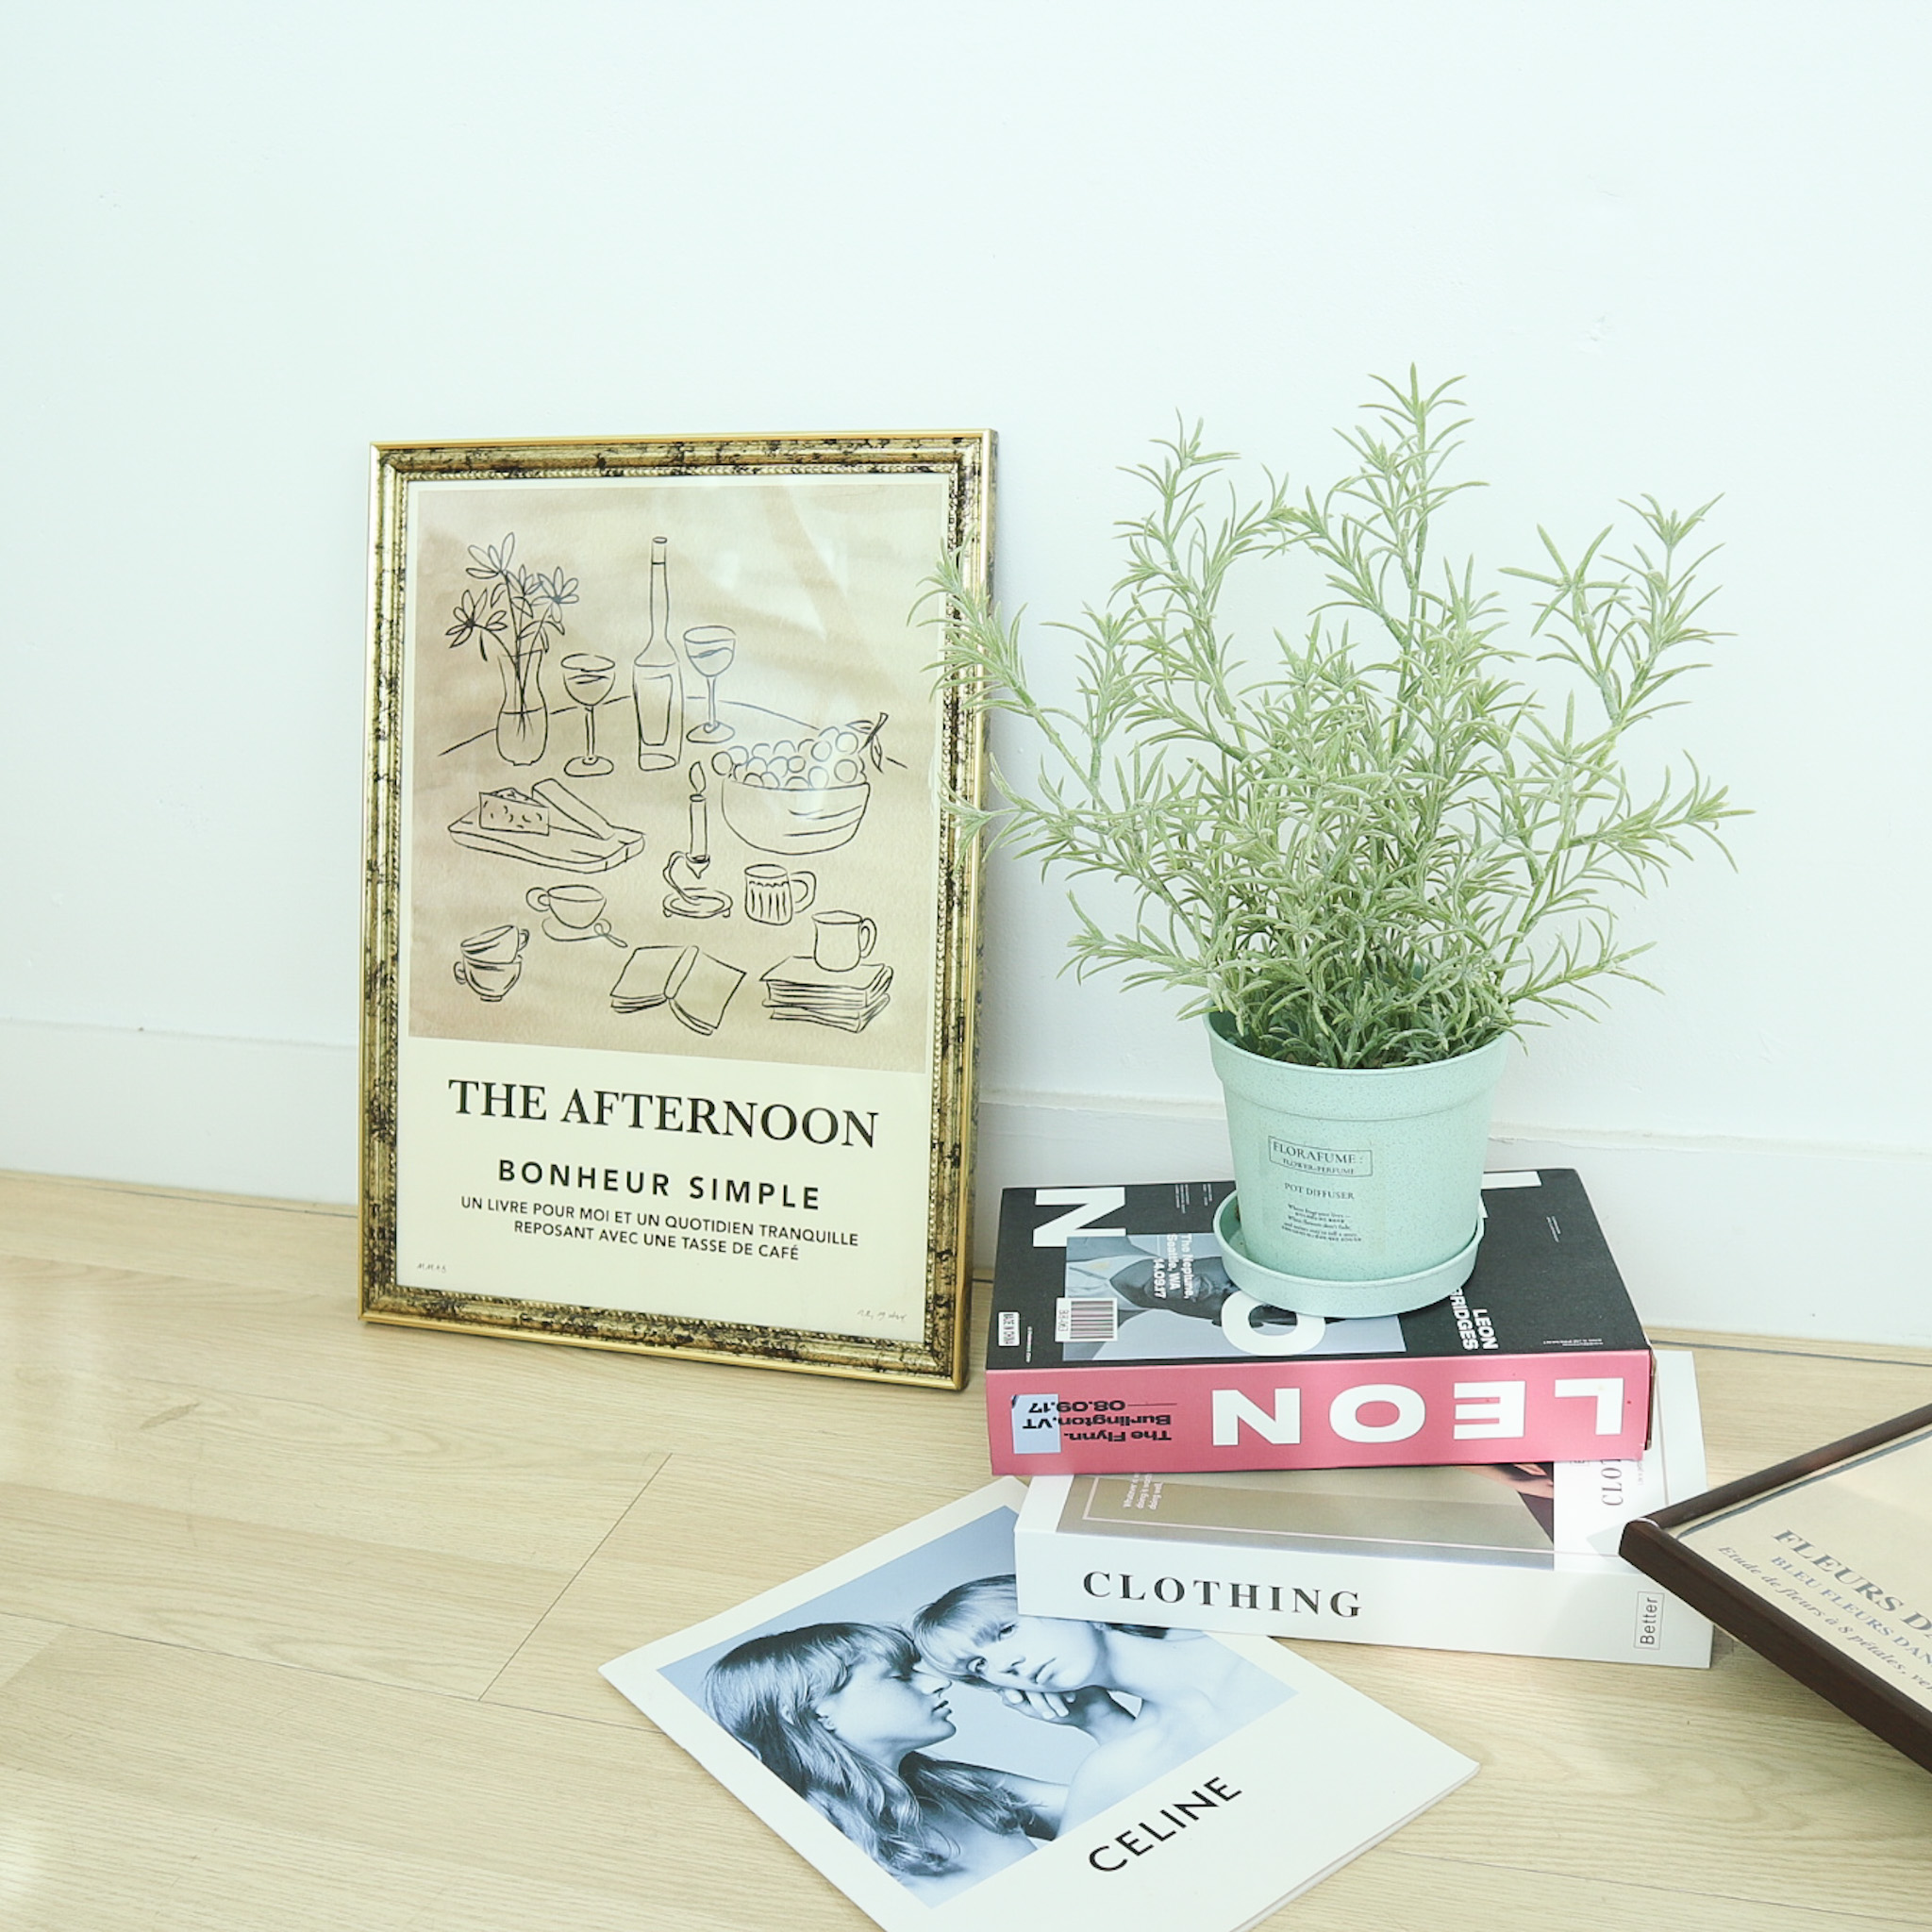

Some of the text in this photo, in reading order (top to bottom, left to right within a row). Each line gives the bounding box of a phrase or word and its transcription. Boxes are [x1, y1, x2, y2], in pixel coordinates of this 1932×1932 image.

[448, 1078, 879, 1148] THE AFTERNOON
[499, 1159, 819, 1210] BONHEUR SIMPLE
[1284, 1182, 1356, 1200] POT DIFFUSER
[461, 1196, 859, 1246] UN LIVRE POUR MOI ET UN QUOTIDIEN TRANQUILLE
[514, 1221, 799, 1260] REPOSANT AVEC UNE TASSE DE CAFÉ
[1180, 1233, 1192, 1252] The
[1169, 1272, 1180, 1291] WA
[1473, 1308, 1499, 1350] LEON
[1028, 1400, 1126, 1413] 08.09.17
[1212, 1376, 1624, 1446] LEON
[1130, 1430, 1172, 1441] The
[1083, 1571, 1361, 1618] CLOTHING
[1761, 1575, 1781, 1587] de
[1774, 1589, 1825, 1616] fleurs
[1771, 1529, 1932, 1638] FLEURS D
[1772, 1557, 1822, 1588] BLEU
[1820, 1590, 1894, 1636] FLEURS
[1640, 1597, 1659, 1645] Better
[1089, 1776, 1242, 1872] CELINE
